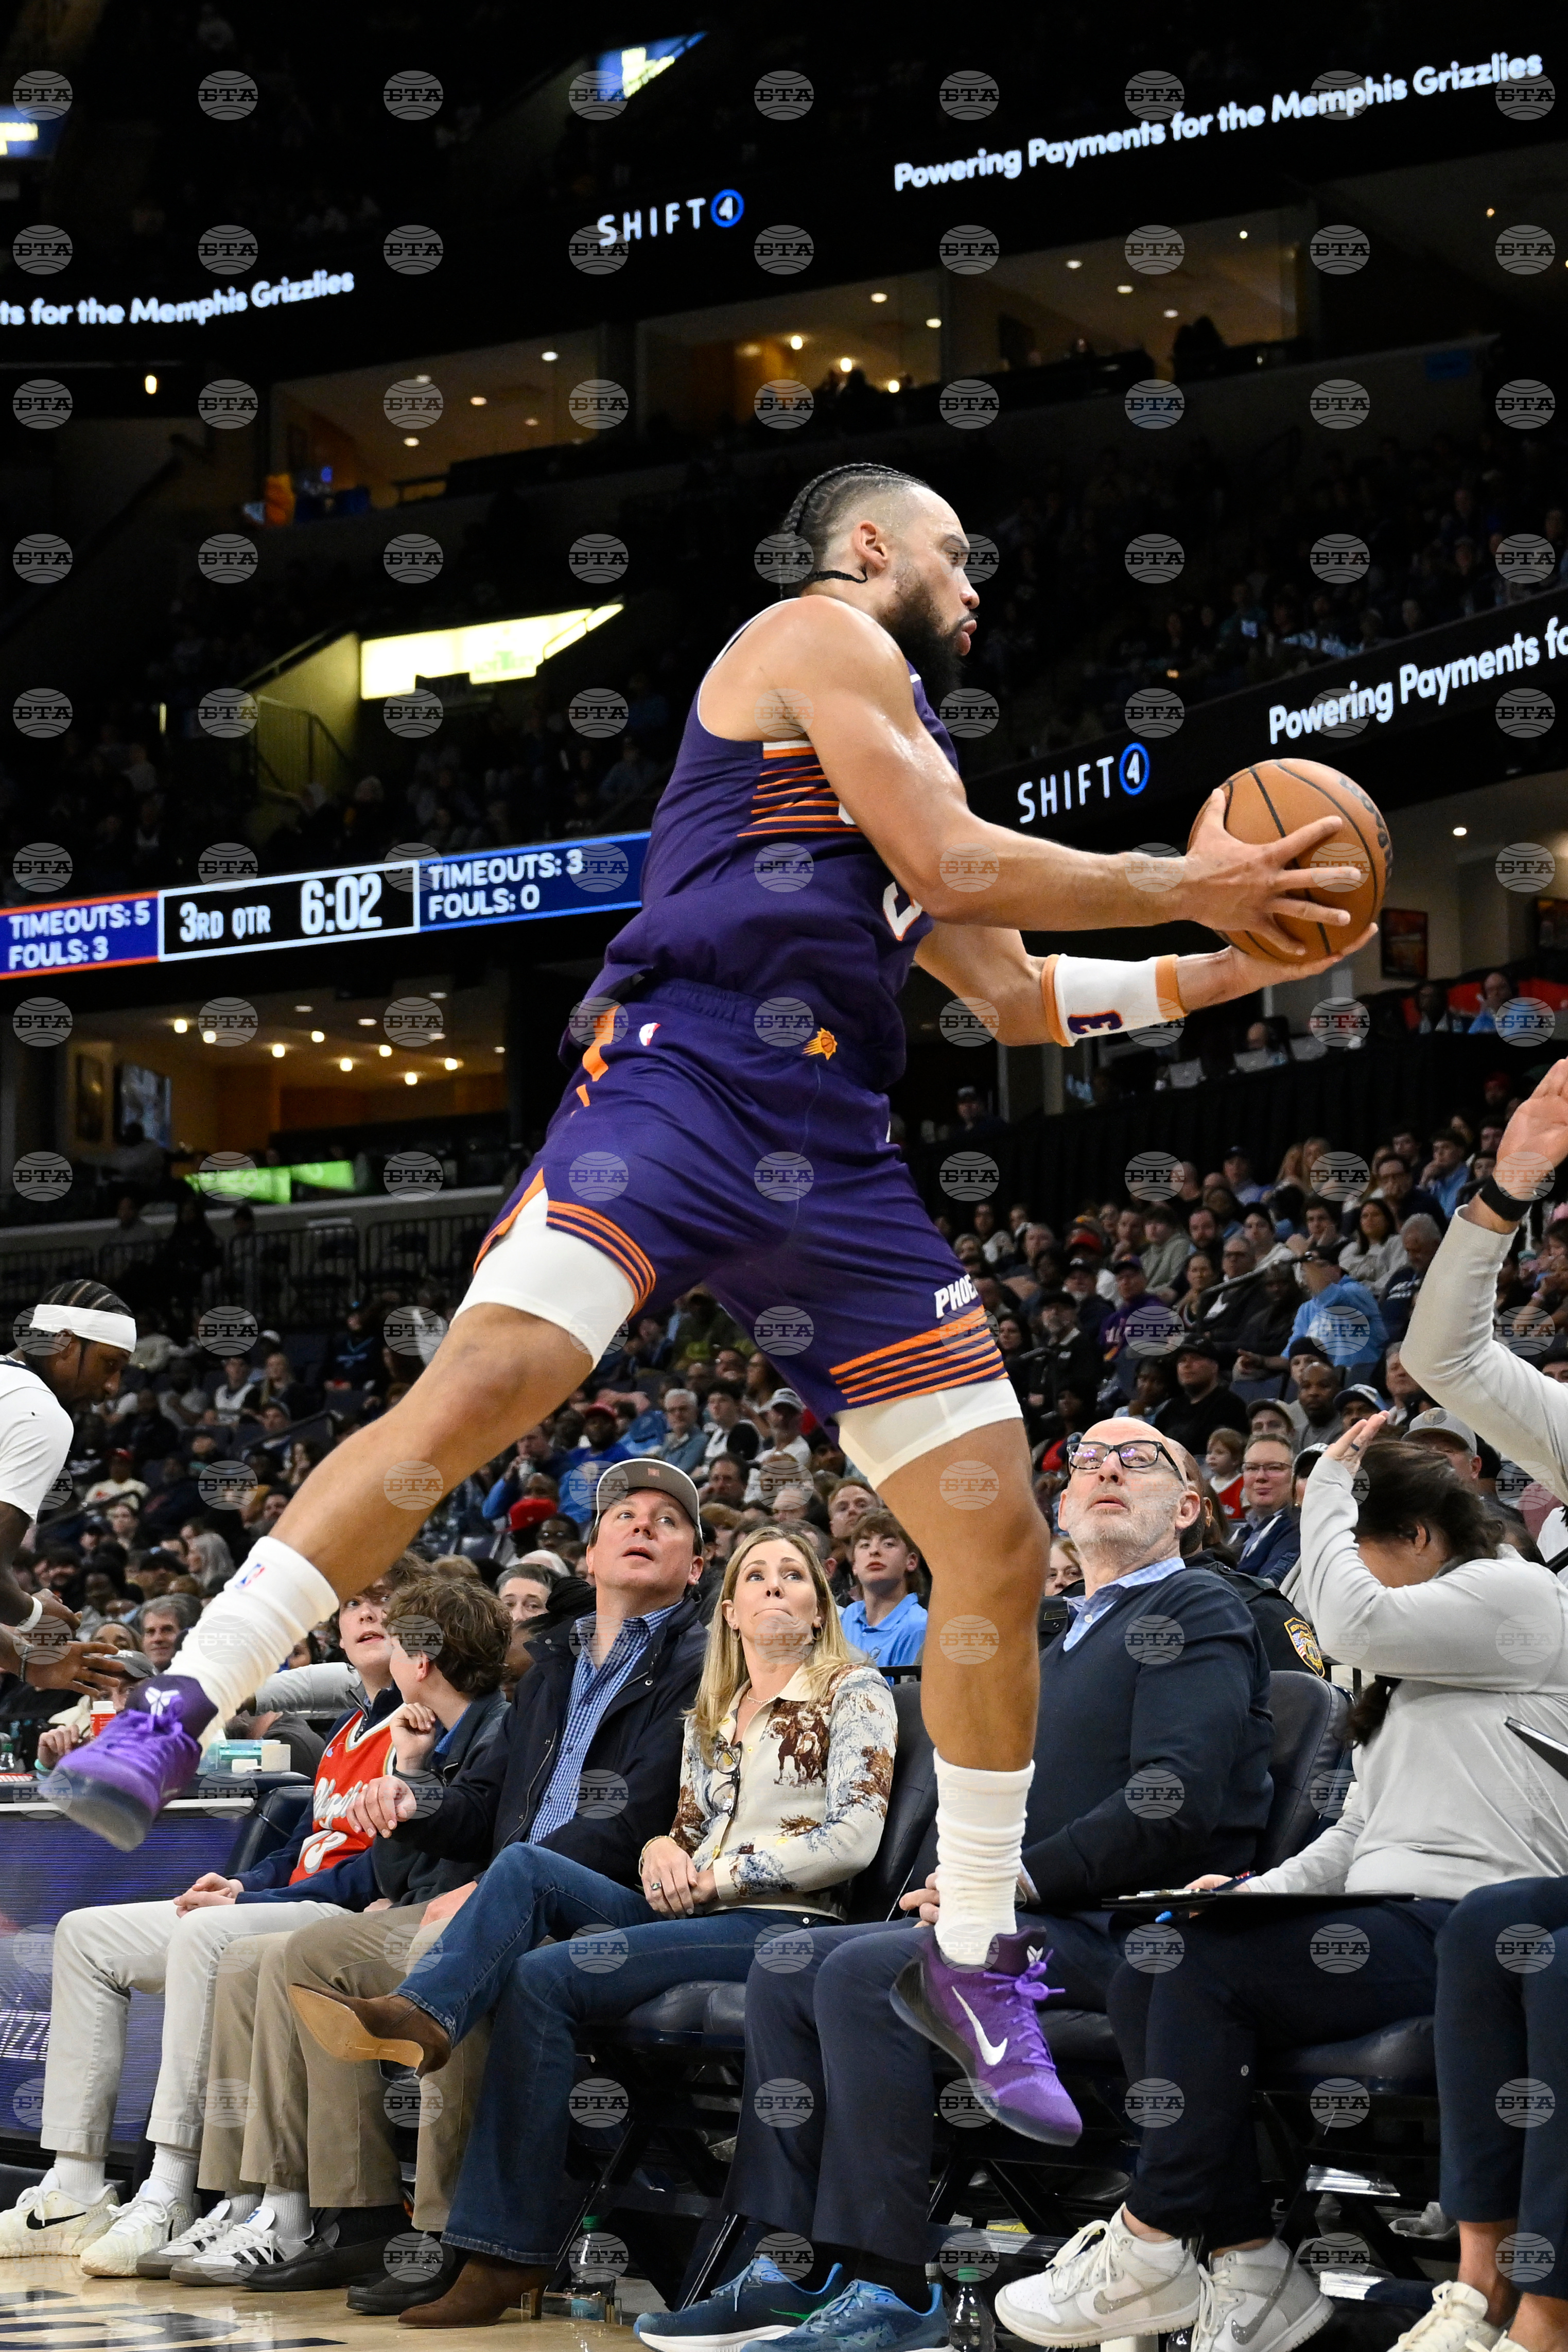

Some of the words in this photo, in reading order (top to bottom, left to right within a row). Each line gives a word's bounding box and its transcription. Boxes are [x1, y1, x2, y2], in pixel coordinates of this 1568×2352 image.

[895, 148, 1022, 192] Powering
[1029, 120, 1165, 167] Payments
[1170, 111, 1215, 142] for
[1216, 99, 1264, 132] the
[1271, 74, 1407, 124] Memphis
[1412, 51, 1543, 96] Grizzlies
[31, 299, 74, 324] for
[78, 297, 126, 325] the
[130, 287, 247, 325] Memphis
[251, 269, 355, 308] Grizzlies
[1269, 681, 1393, 744] Powering
[1399, 632, 1540, 705] Payments
[427, 852, 561, 891] TIMEOUTS:
[565, 848, 583, 875] 3
[8, 903, 131, 940] TIMEOUTS:
[134, 900, 150, 926] 5
[179, 902, 224, 942] 3RD
[231, 904, 271, 939] QTR
[301, 873, 381, 935] 6:02
[428, 890, 516, 921] FOULS:
[520, 884, 541, 910] 0
[8, 940, 89, 970] FOULS:
[92, 935, 109, 961] 3
